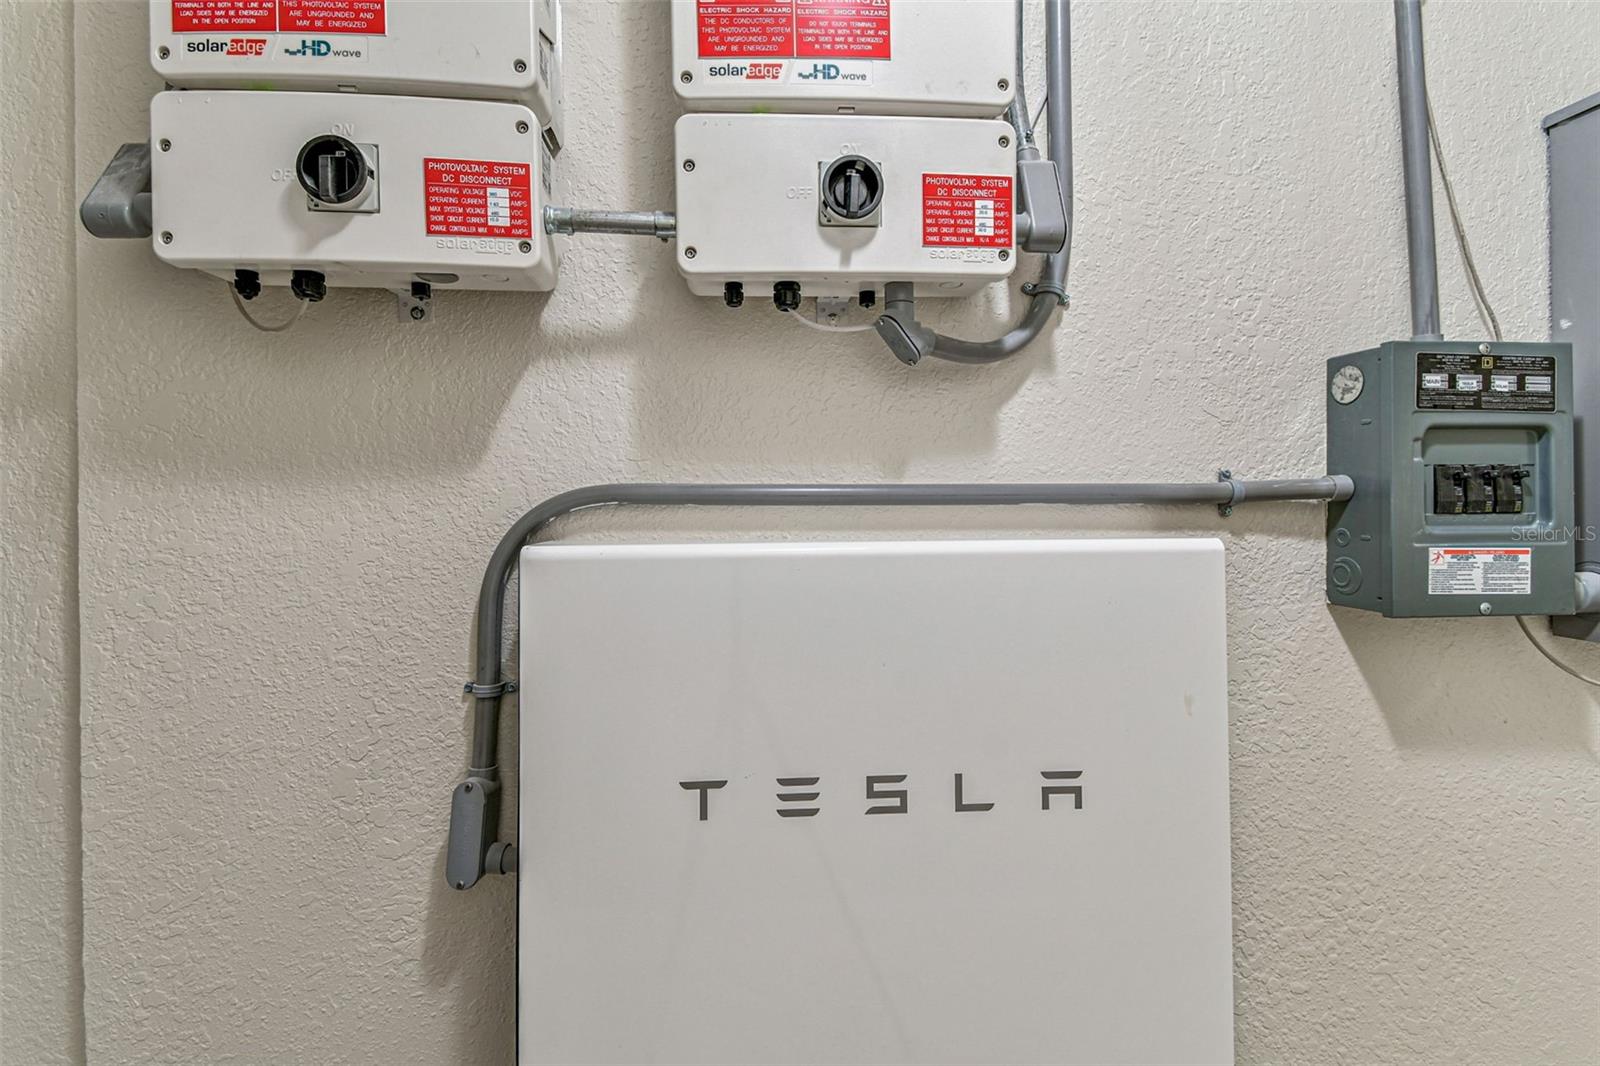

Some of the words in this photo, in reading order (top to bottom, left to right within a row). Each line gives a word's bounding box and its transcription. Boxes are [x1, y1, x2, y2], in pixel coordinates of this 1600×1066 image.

[187, 38, 268, 56] solaredge
[301, 40, 331, 56] HD
[332, 50, 361, 58] wave
[709, 63, 783, 79] solaredge
[813, 64, 840, 80] HD
[330, 123, 354, 136] ON
[272, 168, 296, 182] OF
[428, 162, 488, 173] PHOTOVOLTAIC
[493, 166, 525, 175] SYSTEM
[442, 174, 455, 182] DC
[460, 175, 512, 185] DISCONNECT
[926, 177, 977, 186] PHOTOVOLTAIC
[429, 186, 459, 194] OPERATING
[786, 186, 813, 199] OFF
[952, 189, 997, 197] DISCONNECT
[678, 770, 1083, 821] TESLA
